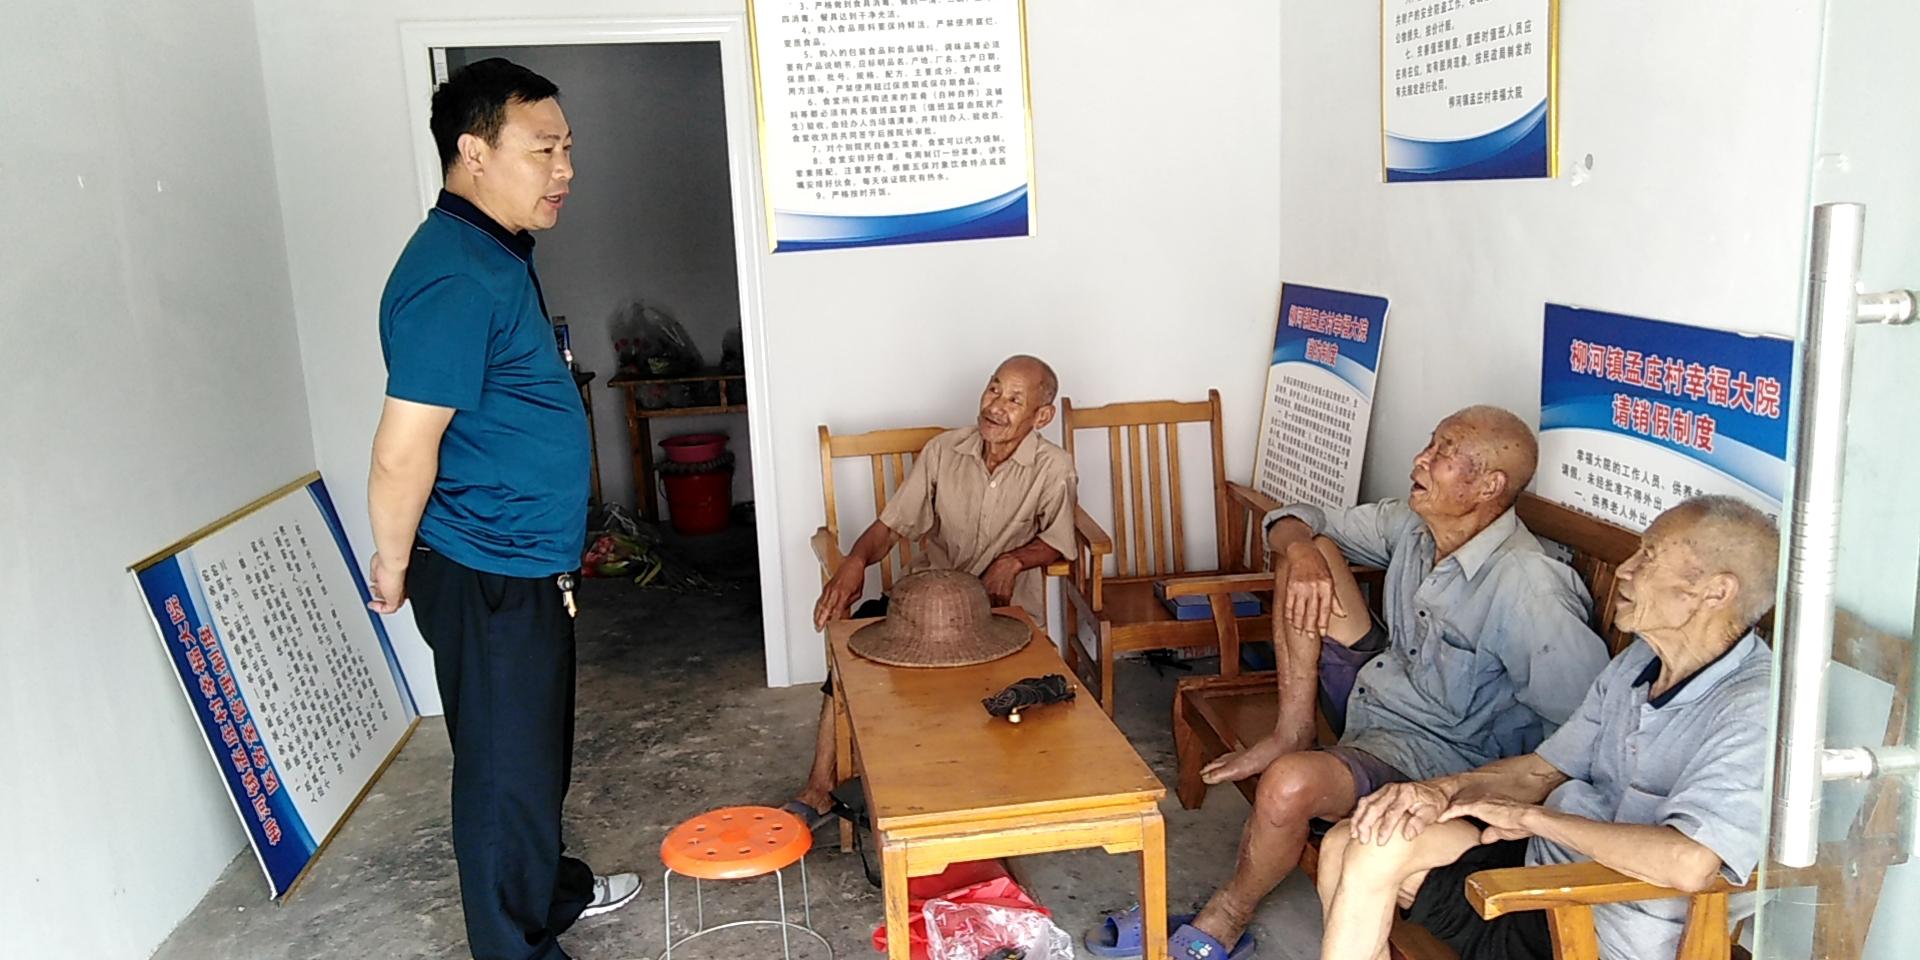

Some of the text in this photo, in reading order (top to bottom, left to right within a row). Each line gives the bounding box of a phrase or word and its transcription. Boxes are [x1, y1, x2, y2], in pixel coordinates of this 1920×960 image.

[1448, 84, 1523, 109] 柳河镇孟庄村幸福大院
[1569, 337, 1782, 419] 柳河镇孟庄村幸福大院
[1610, 391, 1716, 454] 请销假制度
[162, 591, 282, 849] 柳河镇孟庄村幸福大院
[195, 621, 280, 797] 医务室管理制度
